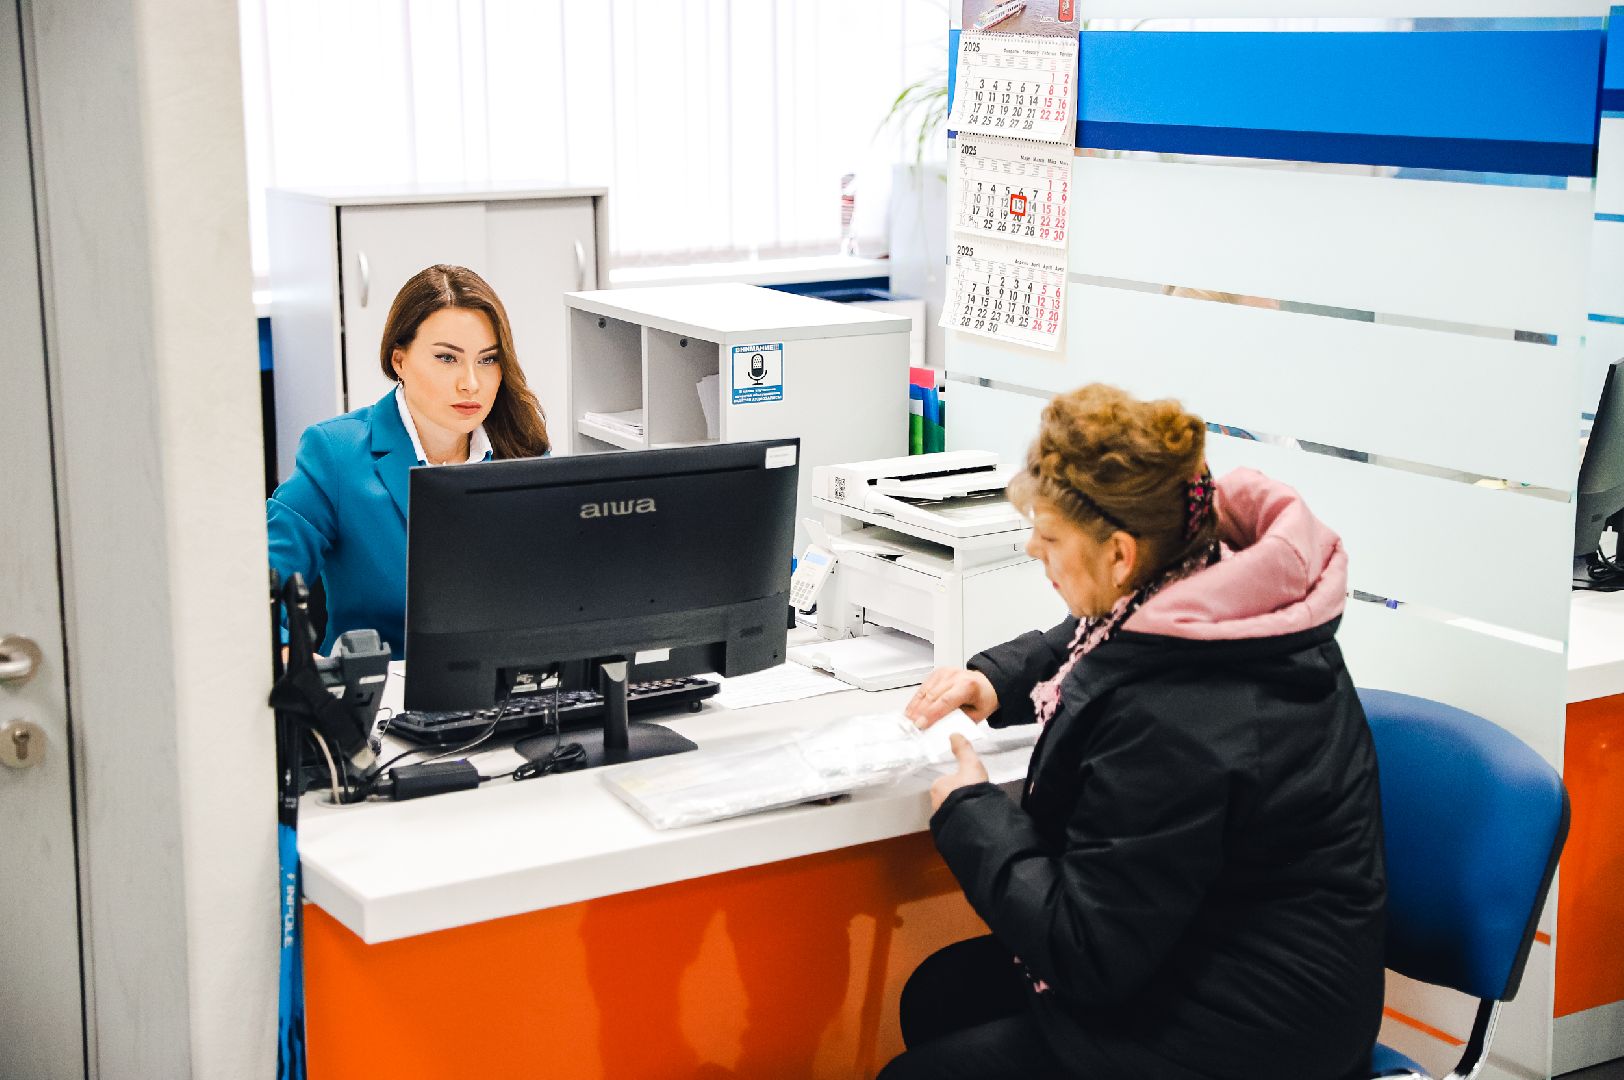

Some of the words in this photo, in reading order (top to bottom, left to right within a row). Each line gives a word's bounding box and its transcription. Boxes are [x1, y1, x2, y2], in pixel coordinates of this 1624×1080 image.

[964, 42, 980, 52] 2025
[980, 79, 984, 88] 3
[993, 81, 998, 90] 4
[1006, 82, 1012, 91] 5
[1021, 83, 1025, 92] 6
[1035, 84, 1040, 94] 7
[1049, 85, 1054, 95] 8
[1064, 86, 1068, 96] 9
[1064, 74, 1069, 84] 2
[975, 91, 983, 101] 10
[989, 92, 996, 102] 11
[1001, 94, 1010, 103] 12
[1016, 95, 1024, 105] 13
[1029, 96, 1038, 106] 14
[1044, 98, 1052, 107] 15
[1058, 99, 1066, 109] 16
[973, 103, 981, 113] 17
[987, 105, 994, 114] 18
[1000, 106, 1008, 115] 19
[1012, 107, 1022, 116] 20
[1027, 108, 1036, 118] 21
[1040, 110, 1051, 120] 22
[1055, 111, 1065, 121] 23
[968, 114, 978, 124] 24
[981, 116, 992, 125] 25
[995, 118, 1005, 127] 26
[1009, 119, 1019, 128] 27
[1023, 120, 1033, 130] 28
[961, 144, 976, 155] 2025
[978, 183, 982, 192] 3
[991, 185, 996, 194] 4
[1006, 187, 1010, 196] 5
[1033, 190, 1038, 200] 7
[1047, 192, 1052, 202] 8
[1062, 194, 1067, 204] 9
[1063, 182, 1067, 192] 2
[974, 194, 981, 203] 10
[987, 196, 994, 205] 11
[1001, 198, 1008, 207] 12
[1014, 200, 1023, 210] 13
[1028, 202, 1036, 212] 14
[1043, 204, 1051, 214] 15
[1058, 206, 1066, 216] 16
[972, 205, 980, 215] 17
[986, 207, 994, 217] 18
[1000, 209, 1008, 219] 19
[1027, 215, 1035, 224] 21
[1041, 216, 1051, 226] 22
[1055, 218, 1065, 228] 23
[984, 219, 993, 229] 25
[997, 222, 1006, 231] 26
[1011, 224, 1021, 233] 27
[1025, 226, 1034, 236] 28
[1040, 228, 1049, 238] 29
[1054, 230, 1064, 240] 30
[957, 245, 973, 256] 2025
[972, 283, 976, 292] 7
[986, 286, 989, 295] 8
[1000, 288, 1004, 299] 9
[1010, 290, 1017, 301] 10
[1024, 294, 1030, 303] 11
[1038, 296, 1045, 307] 12
[1052, 299, 1060, 309] 13
[1001, 277, 1005, 286] 2
[1014, 279, 1019, 289] 3
[1028, 283, 1032, 292] 4
[1042, 285, 1047, 294] 5
[1056, 288, 1060, 297] 6
[968, 294, 975, 304] 14
[981, 297, 989, 307] 15
[995, 300, 1002, 309] 16
[1008, 303, 1016, 312] 17
[1022, 305, 1029, 315] 18
[1036, 308, 1044, 318] 19
[1049, 311, 1058, 321] 20
[960, 317, 971, 326] 28
[974, 320, 984, 329] 29
[988, 322, 998, 333] 30
[964, 306, 973, 315] 21
[977, 308, 987, 318] 22
[991, 311, 1001, 321] 23
[1005, 314, 1014, 324] 24
[1019, 317, 1028, 327] 25
[1032, 320, 1042, 330] 26
[1047, 323, 1057, 333] 27
[580, 497, 656, 518] aiwa
